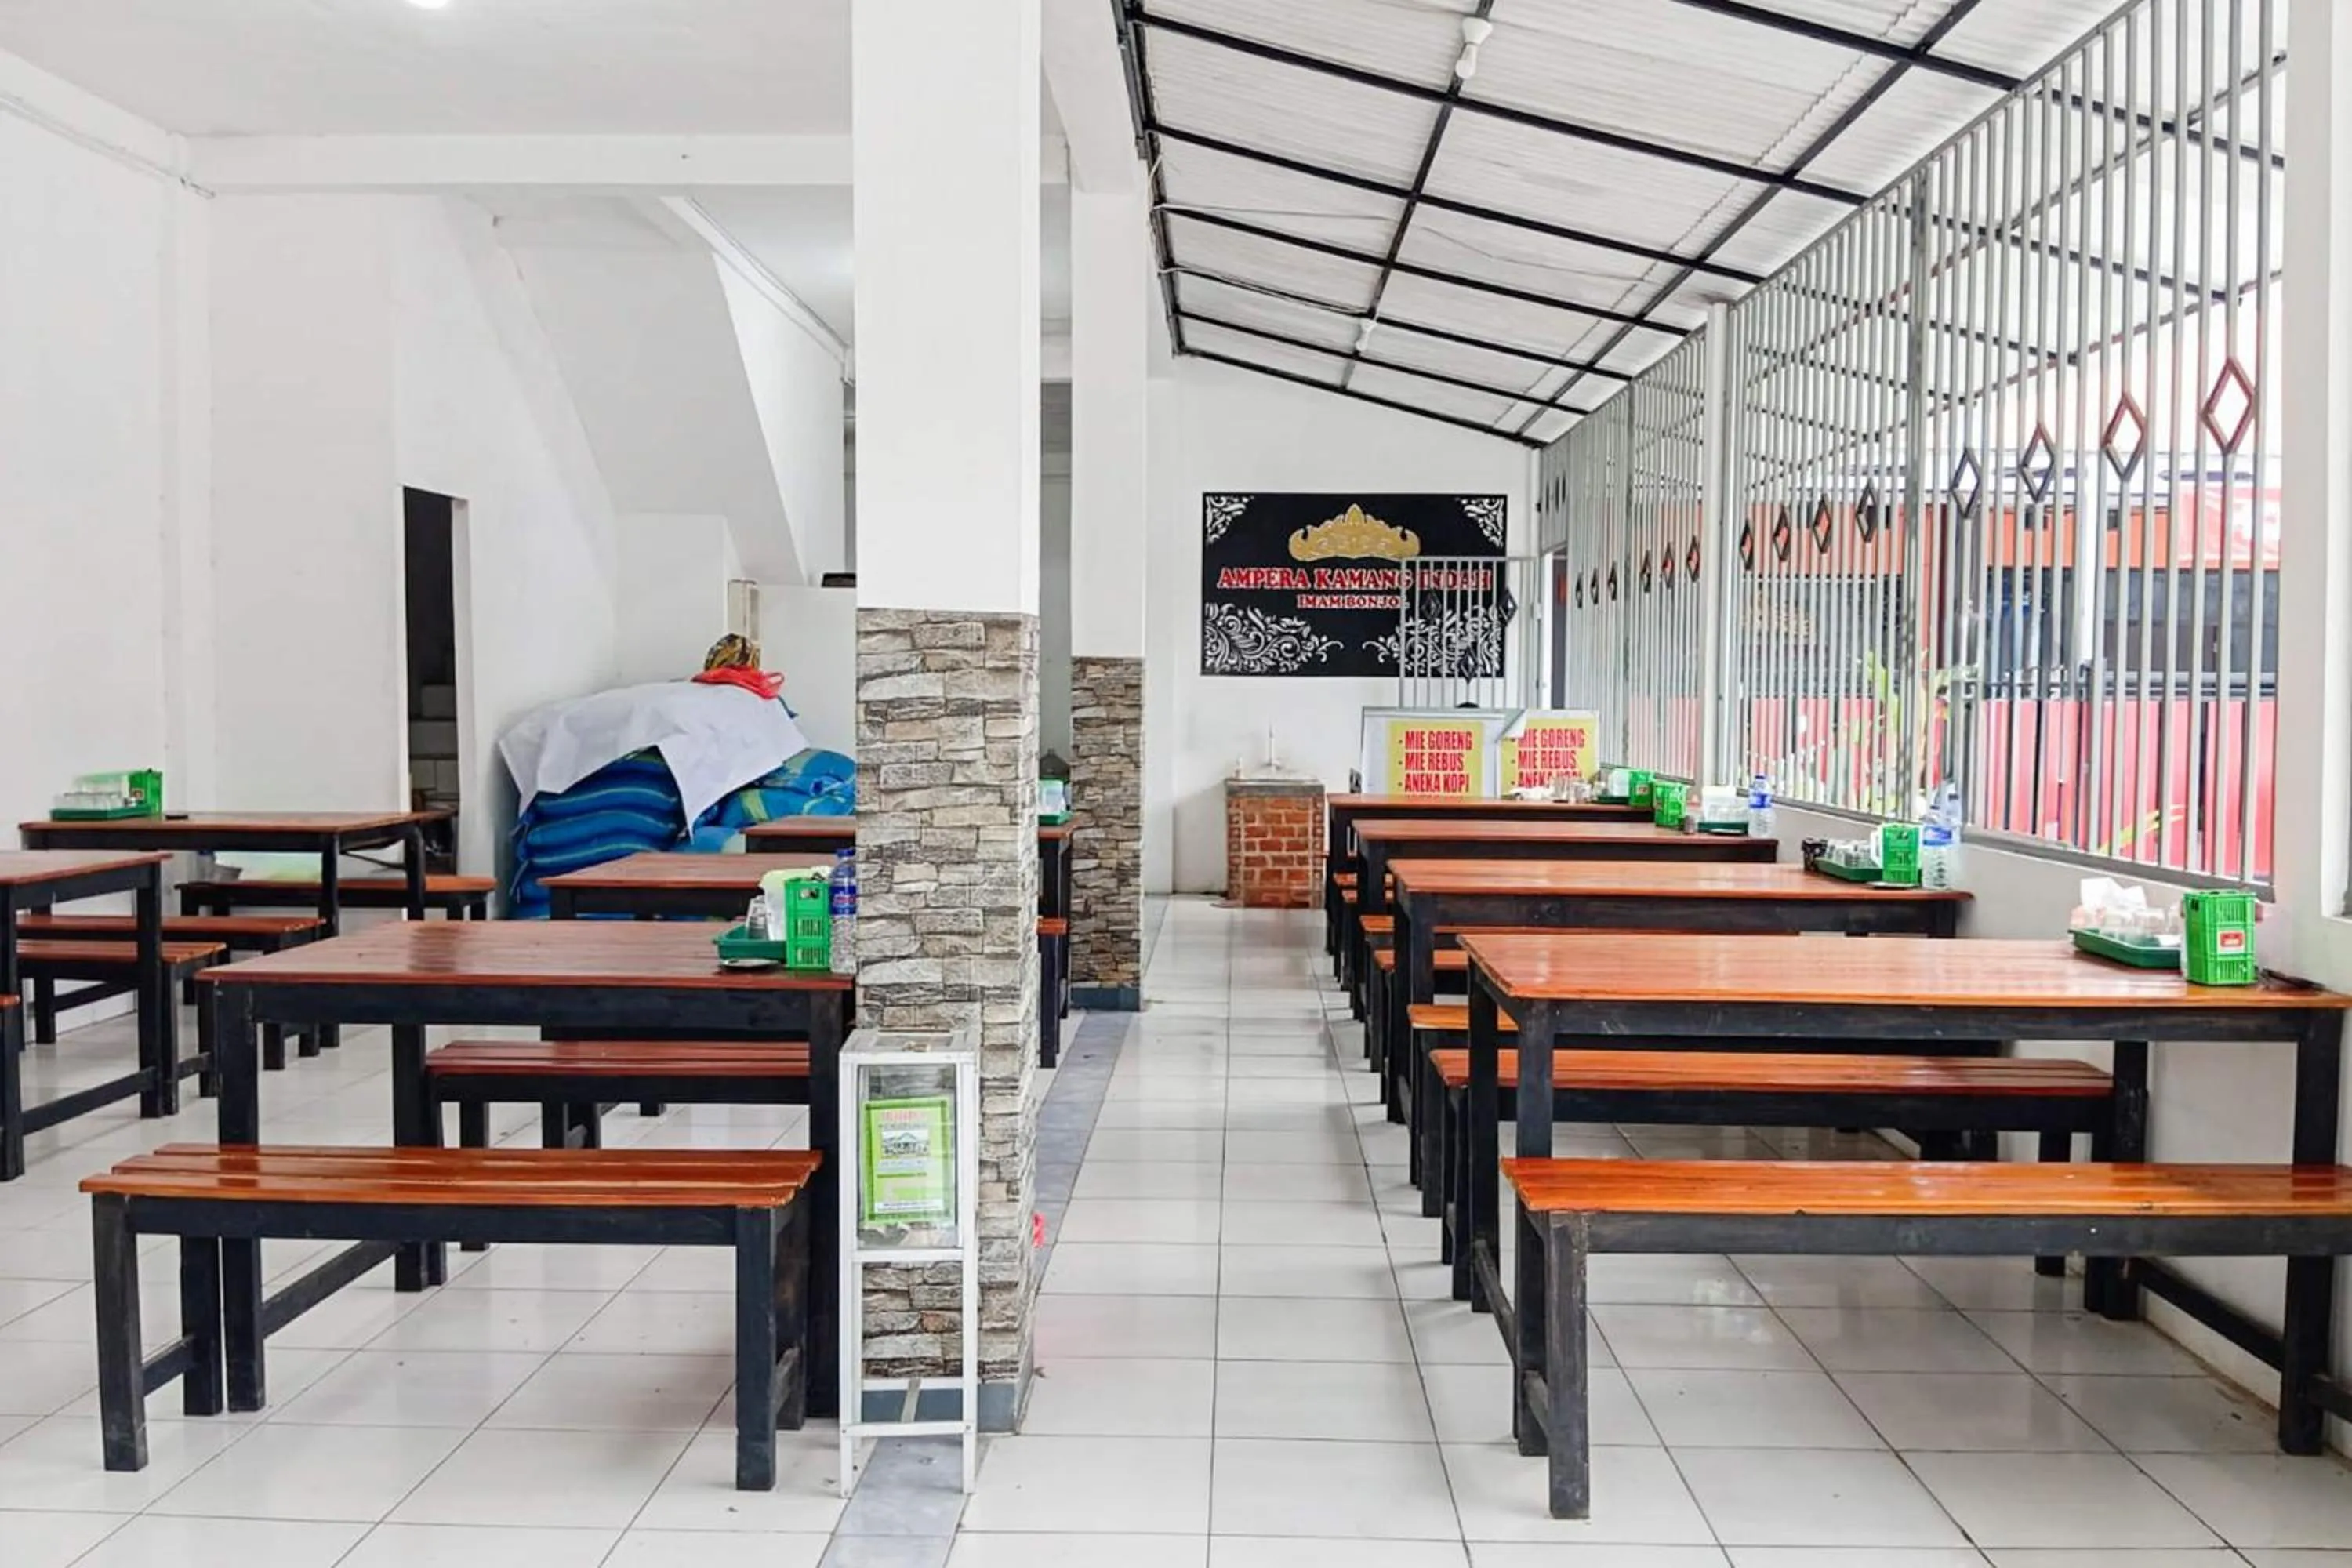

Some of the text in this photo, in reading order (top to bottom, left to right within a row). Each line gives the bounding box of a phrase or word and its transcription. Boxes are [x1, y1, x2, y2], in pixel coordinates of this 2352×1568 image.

[1217, 568, 1311, 589] AMPERA
[1313, 568, 1413, 590] KAMANG
[1405, 731, 1472, 750] MIE GORENG
[1541, 728, 1584, 748] GORENG
[1405, 752, 1464, 771] MIE REBUS
[1517, 750, 1576, 769] MIE REBUS
[1404, 773, 1469, 793] ANEKA KOPI
